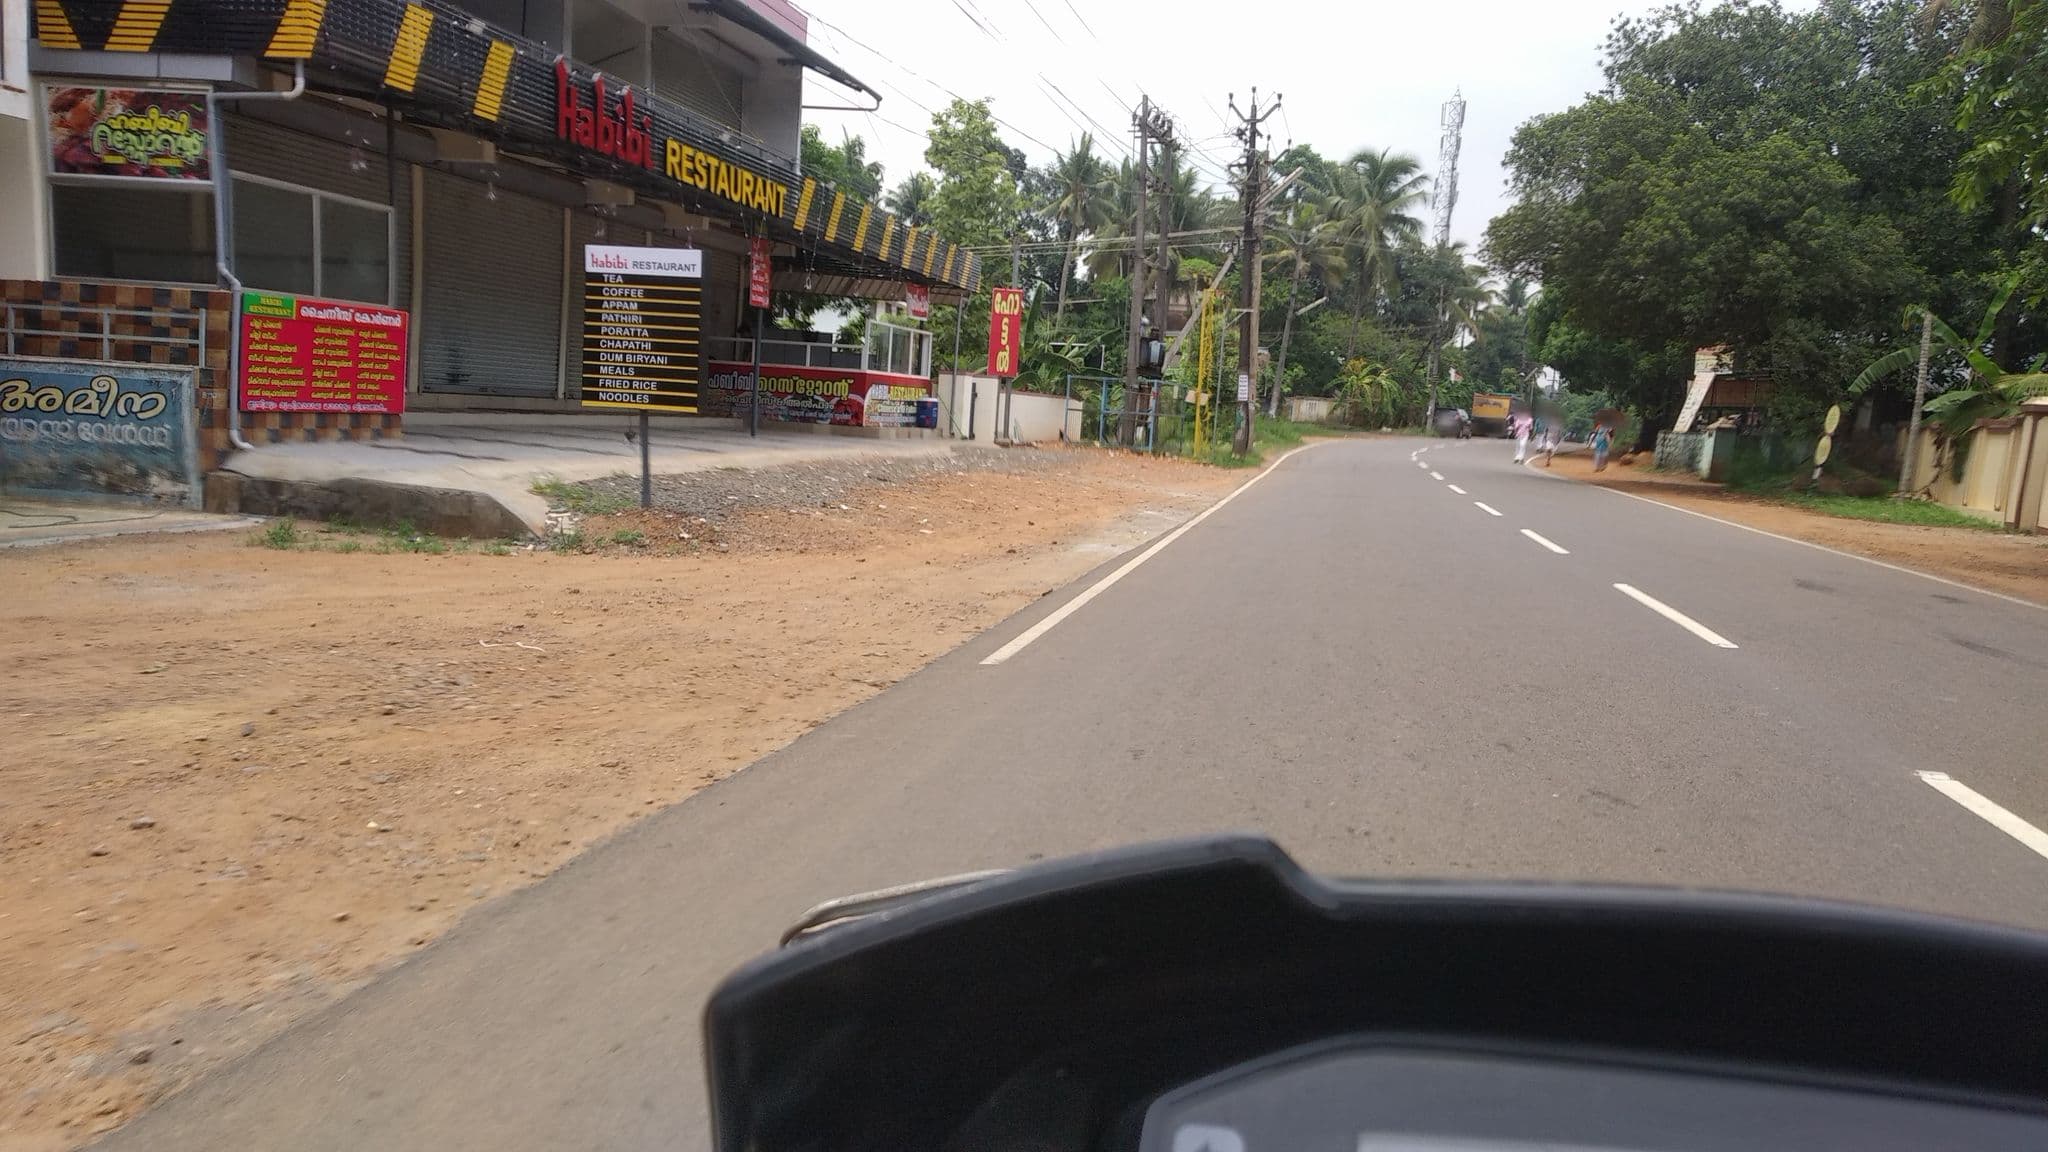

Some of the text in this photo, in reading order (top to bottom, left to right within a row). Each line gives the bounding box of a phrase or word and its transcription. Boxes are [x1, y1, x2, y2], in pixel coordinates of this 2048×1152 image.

[665, 137, 788, 218] RESTAURANT
[632, 260, 697, 273] RESTAURANT
[602, 274, 624, 284] TEA
[602, 288, 644, 298] COFFEE
[602, 301, 638, 310] APPAM
[601, 314, 643, 324] PATHIRI
[600, 327, 649, 337] PORATTA
[599, 340, 651, 350] CHAPATHI
[599, 353, 668, 365] DUM BIRYANI
[600, 366, 635, 376] MEALS
[599, 379, 657, 391] FRIED RICE
[0, 375, 167, 421] അമീന
[599, 392, 650, 404] NOODLES
